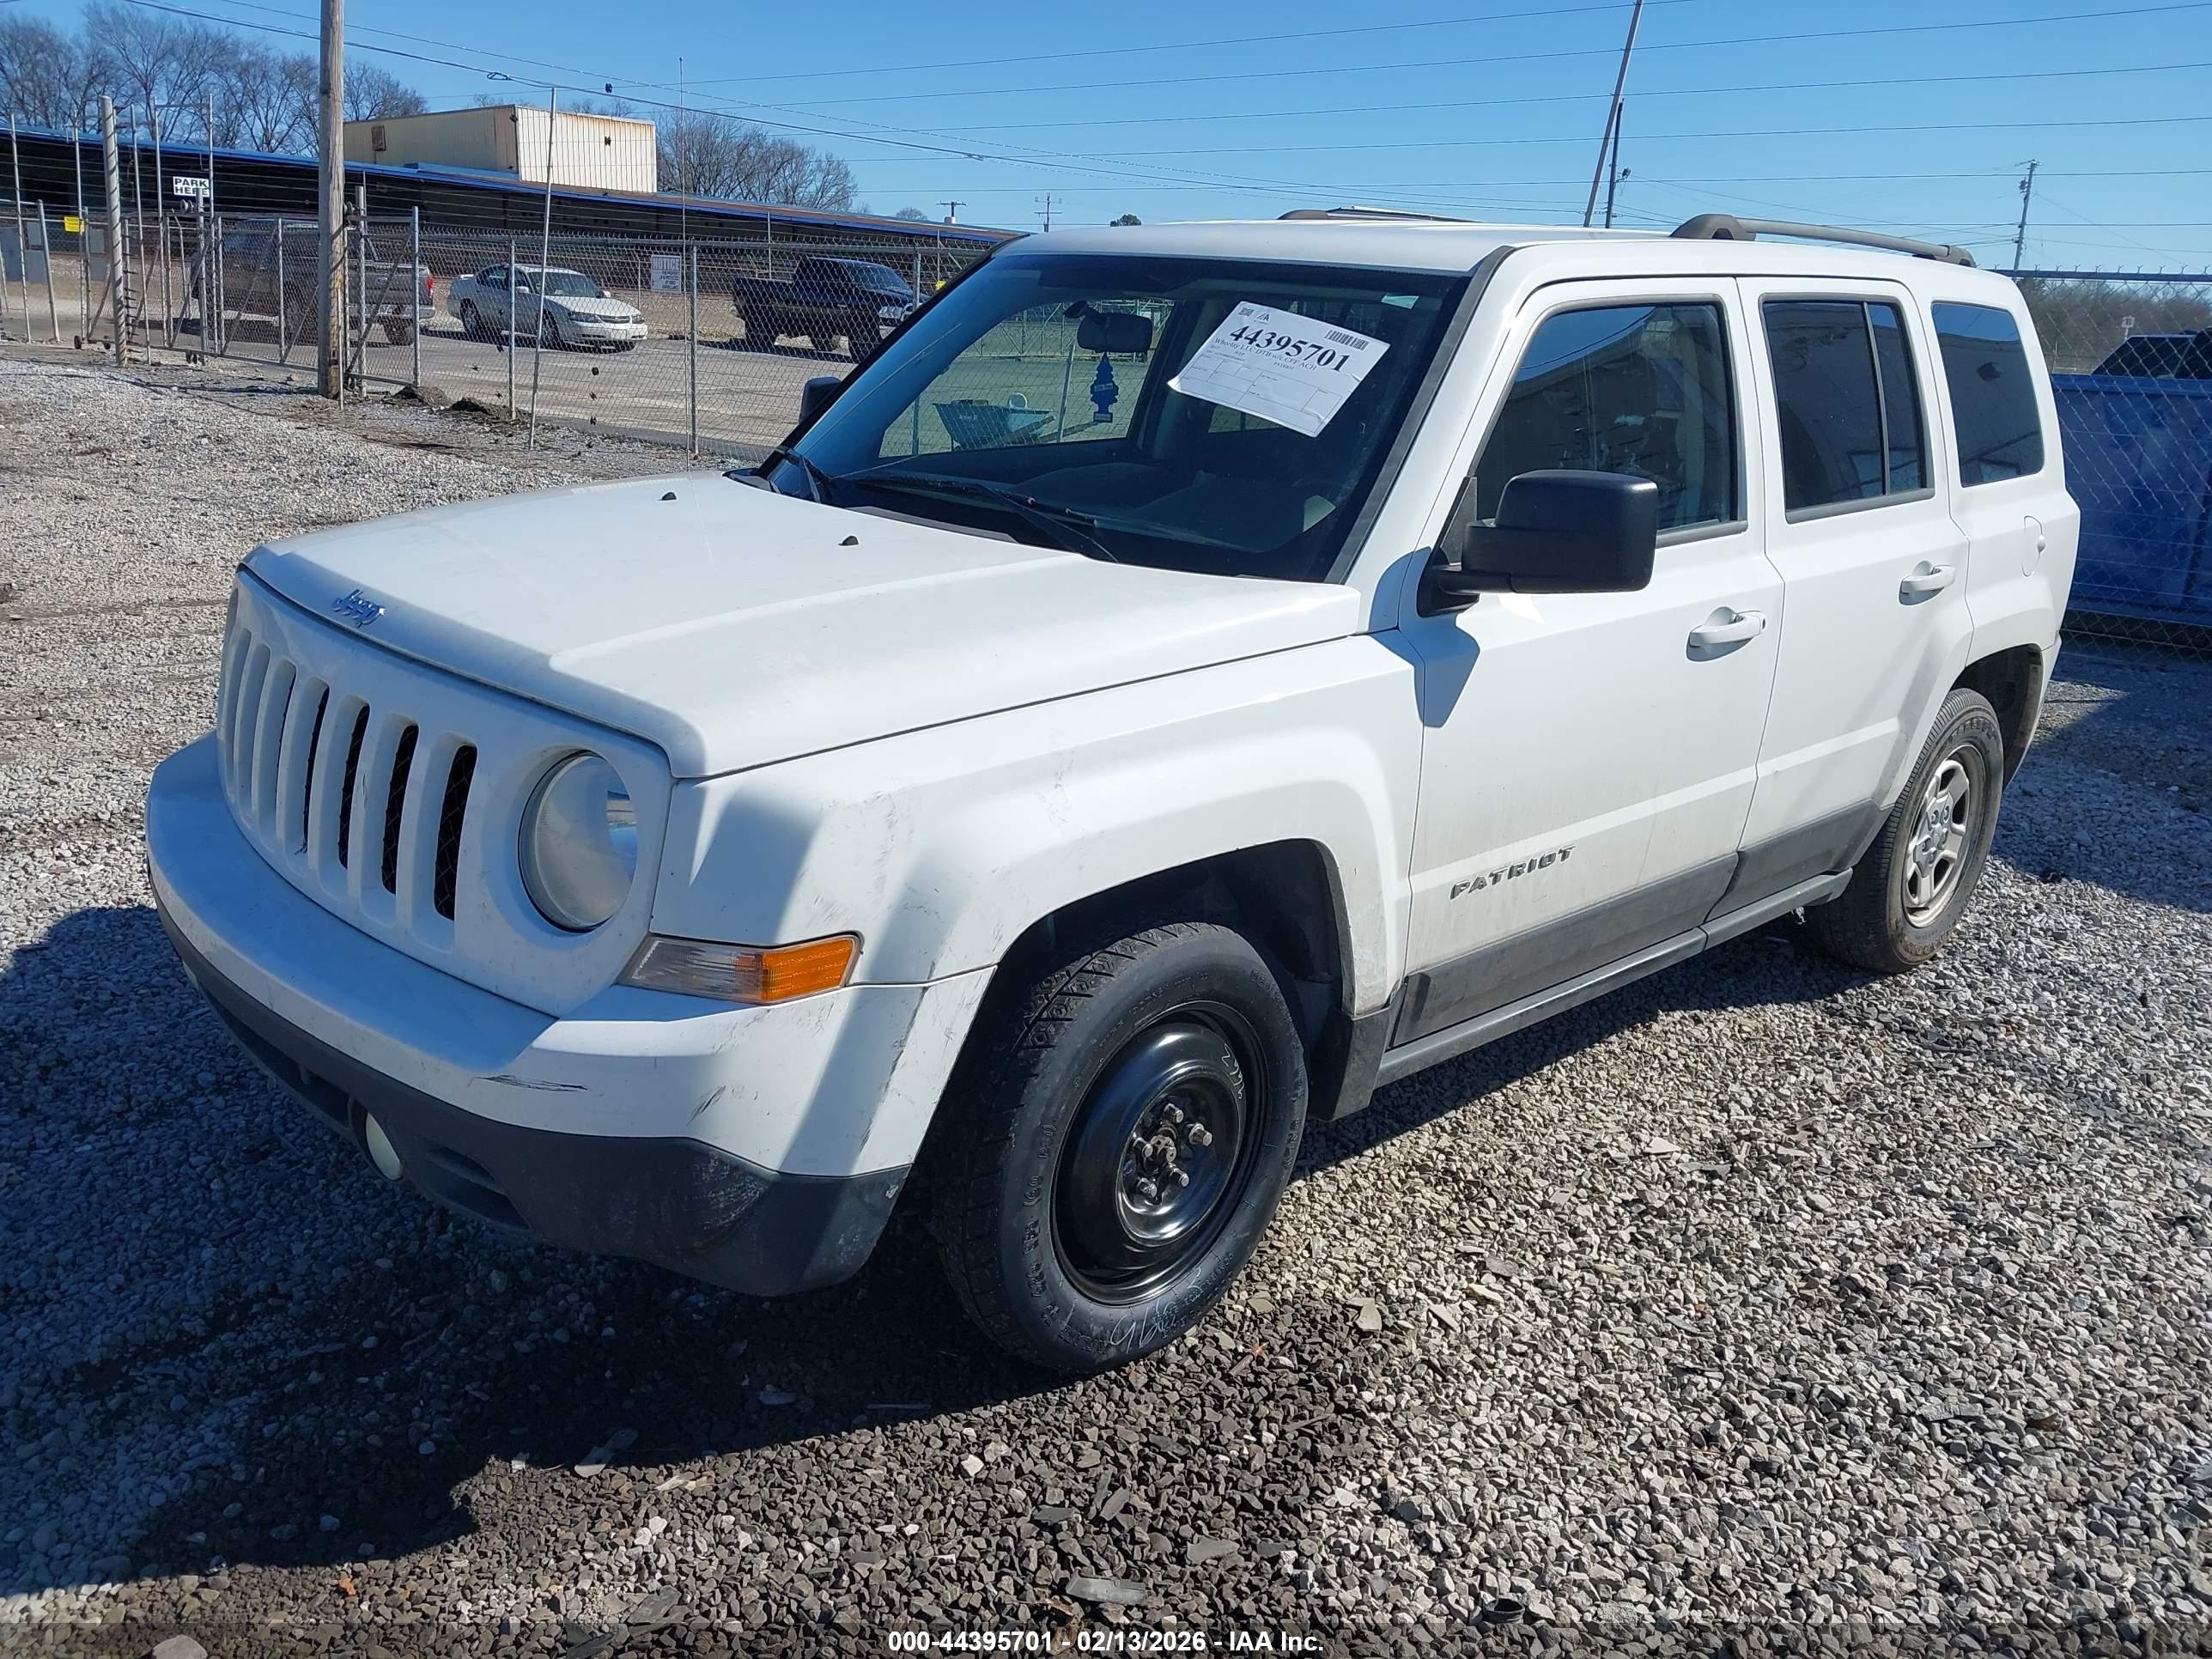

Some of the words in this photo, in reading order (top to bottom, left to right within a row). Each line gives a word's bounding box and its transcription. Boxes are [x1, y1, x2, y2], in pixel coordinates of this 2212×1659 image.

[174, 178, 208, 187] PARK
[653, 257, 680, 270] NOTICE
[1230, 325, 1351, 373] 44395701
[1299, 361, 1317, 371] ACH
[1449, 844, 1577, 900] PATRIOT
